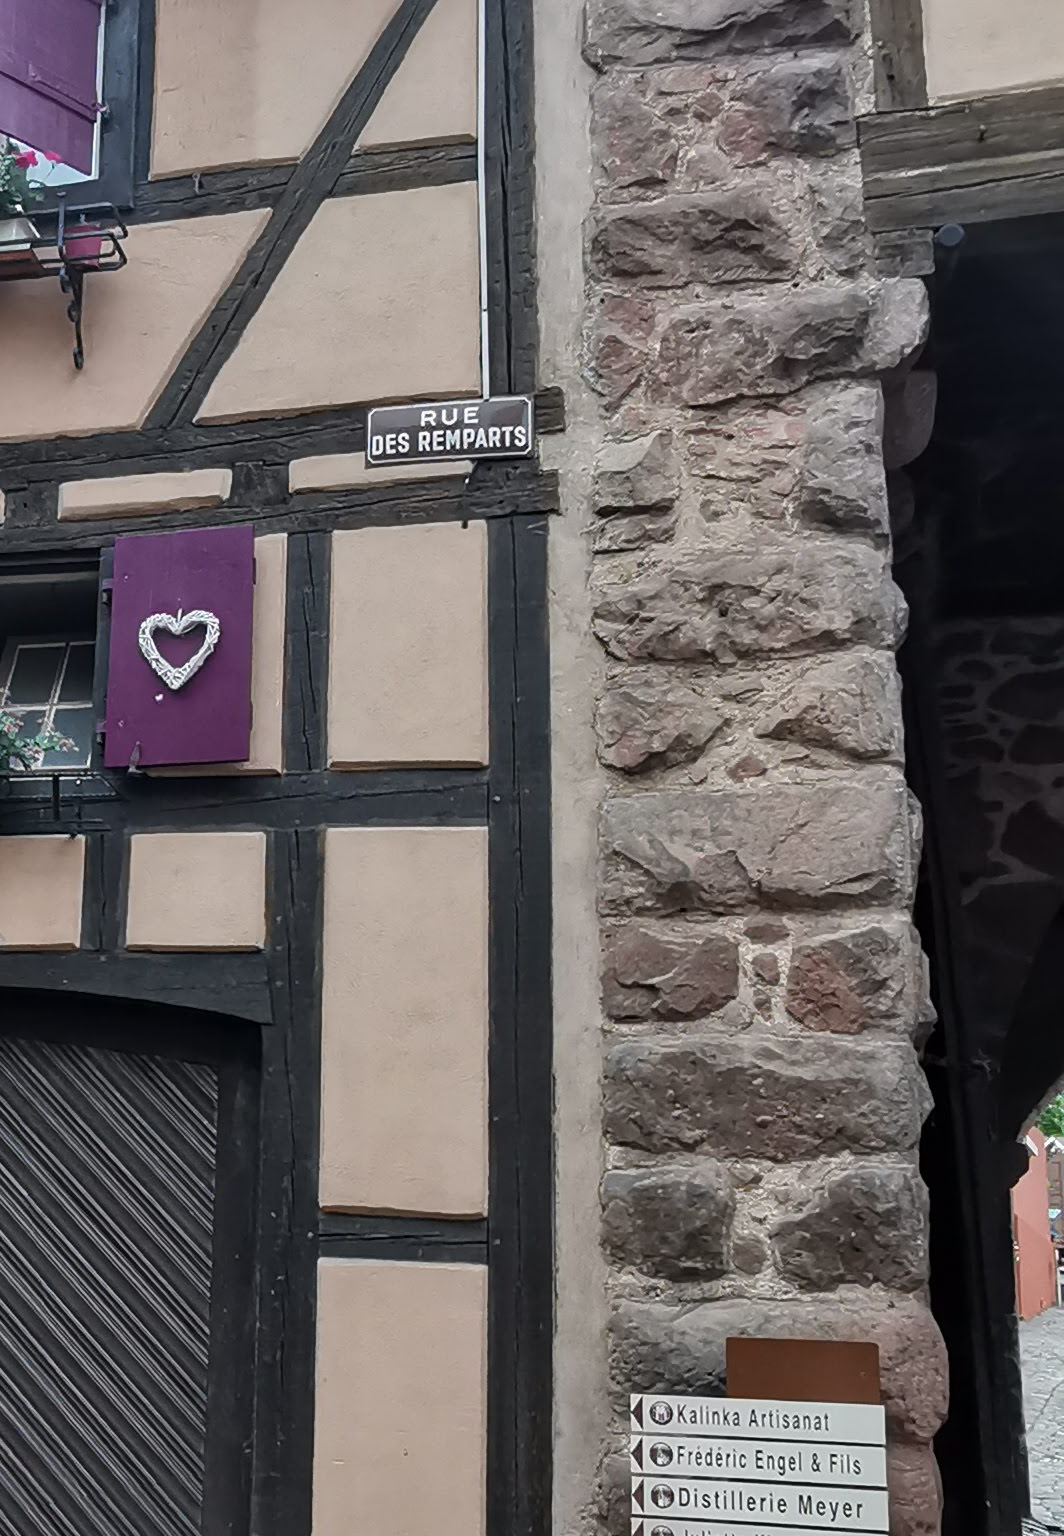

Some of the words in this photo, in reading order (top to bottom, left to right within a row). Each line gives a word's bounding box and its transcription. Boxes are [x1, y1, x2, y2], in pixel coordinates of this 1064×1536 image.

[420, 406, 480, 427] RUE
[371, 432, 410, 456] DES
[418, 426, 527, 452] REMPARTS
[676, 1404, 741, 1427] Kalinka
[748, 1409, 830, 1431] Artisanat
[677, 1445, 747, 1469] Frédéric
[755, 1450, 802, 1476] Engel
[811, 1455, 821, 1472] &
[829, 1454, 862, 1475] Fils
[678, 1488, 787, 1513] Distillerie
[798, 1495, 864, 1523] Meyer
